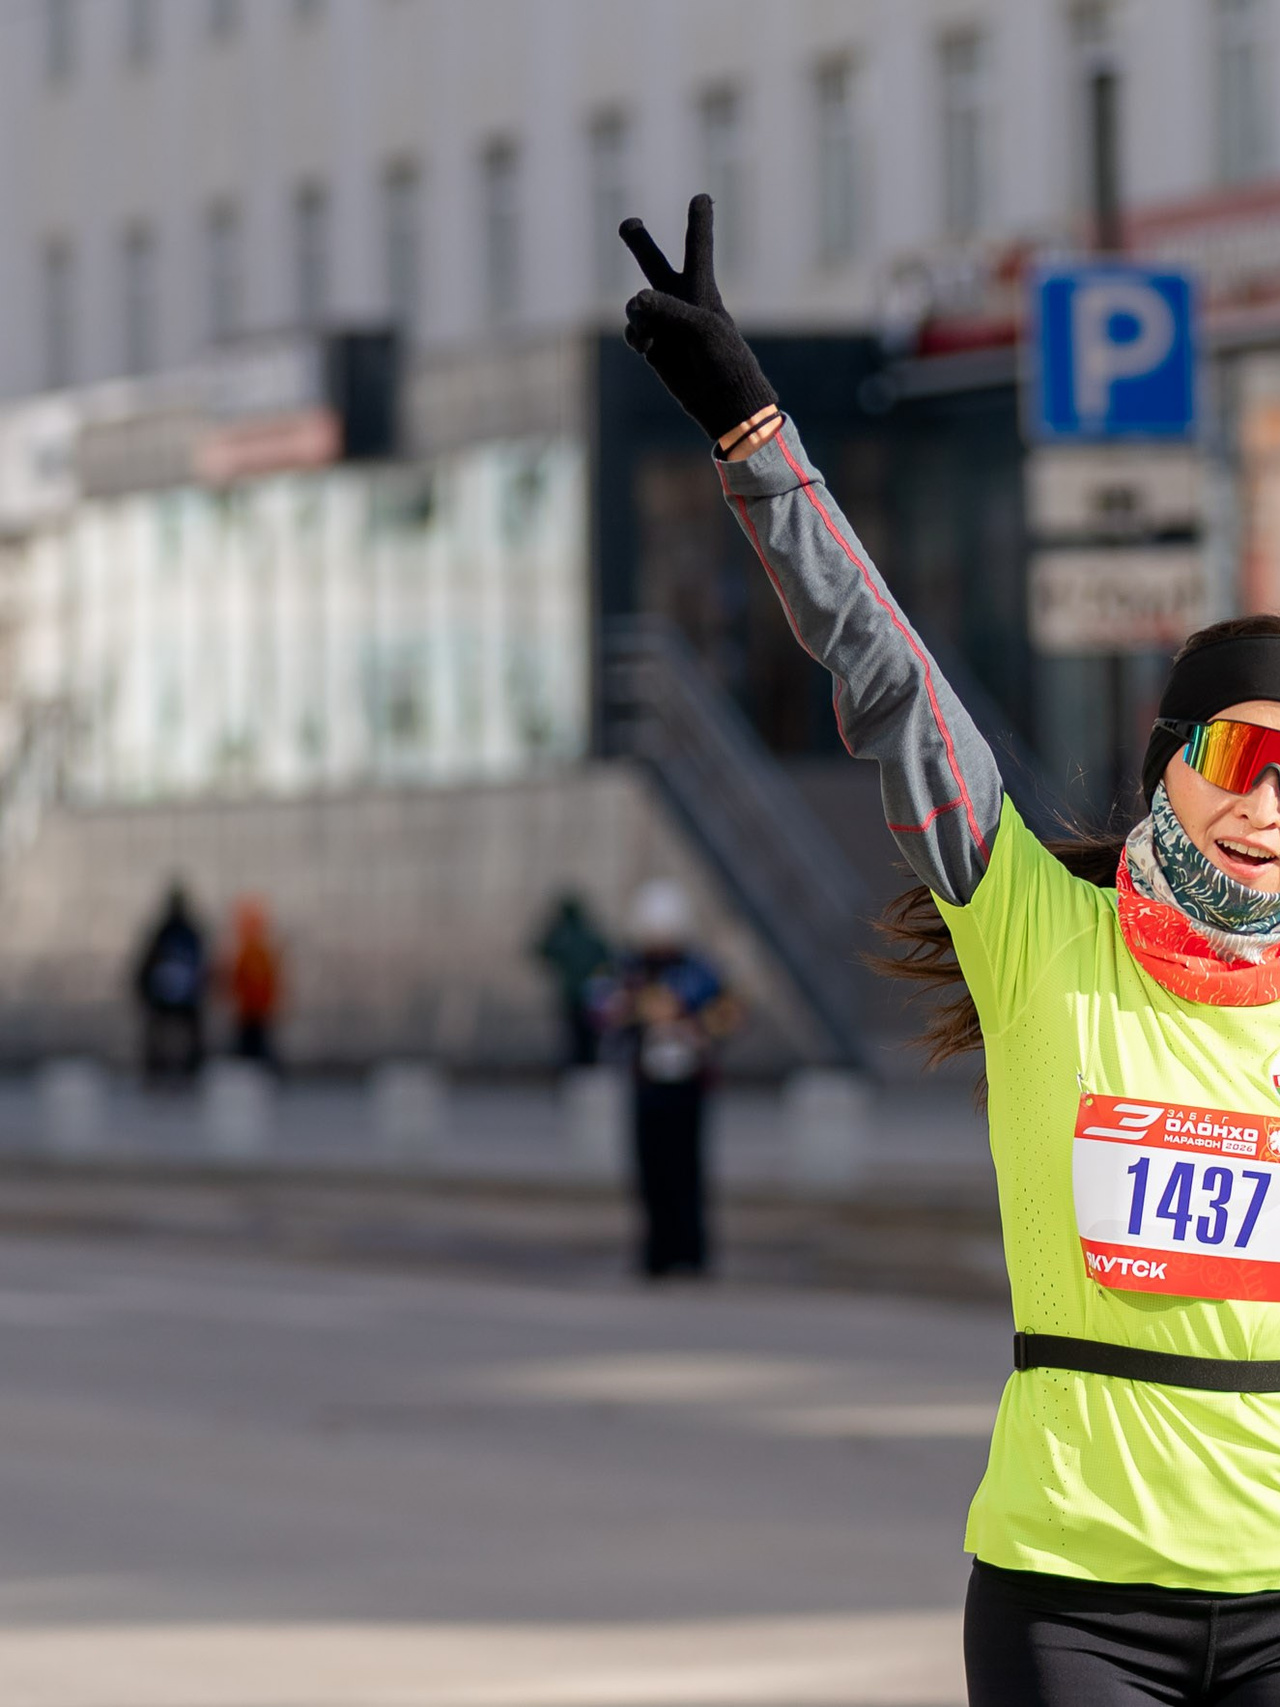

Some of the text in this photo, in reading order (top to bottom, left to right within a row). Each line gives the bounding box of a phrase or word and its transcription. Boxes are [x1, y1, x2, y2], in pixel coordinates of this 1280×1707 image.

[1166, 1109, 1229, 1124] ЗАБЕГ
[1165, 1118, 1259, 1142] ОЛОНХО
[1164, 1134, 1253, 1153] МАРАФОН 2026
[1127, 1157, 1272, 1248] 1437
